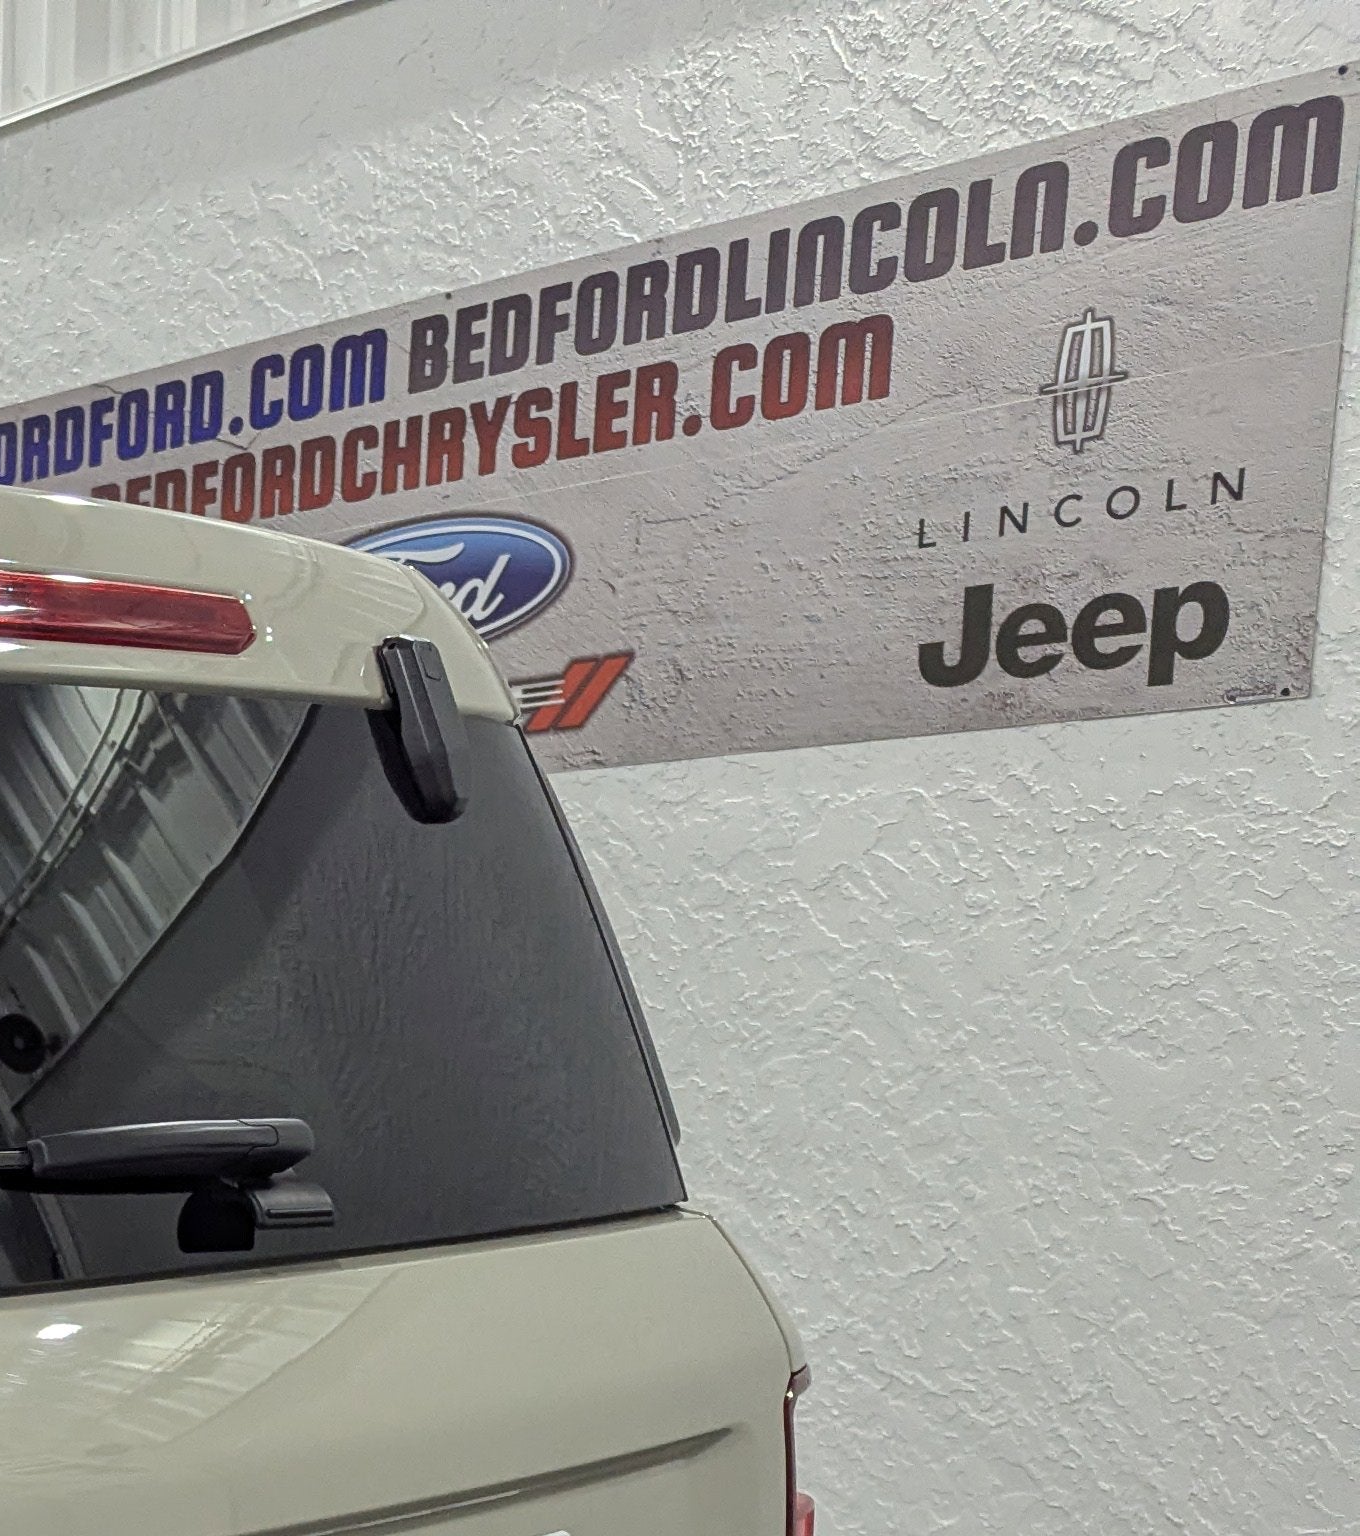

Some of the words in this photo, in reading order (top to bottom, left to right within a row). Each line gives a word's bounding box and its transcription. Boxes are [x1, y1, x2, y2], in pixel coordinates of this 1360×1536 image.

[407, 93, 1345, 396] BEDFORDLINCOLN.COM
[90, 313, 895, 524] DFORDCHRYSLER.COM
[917, 467, 1246, 549] LINCOLN
[917, 580, 1230, 688] Jeep
